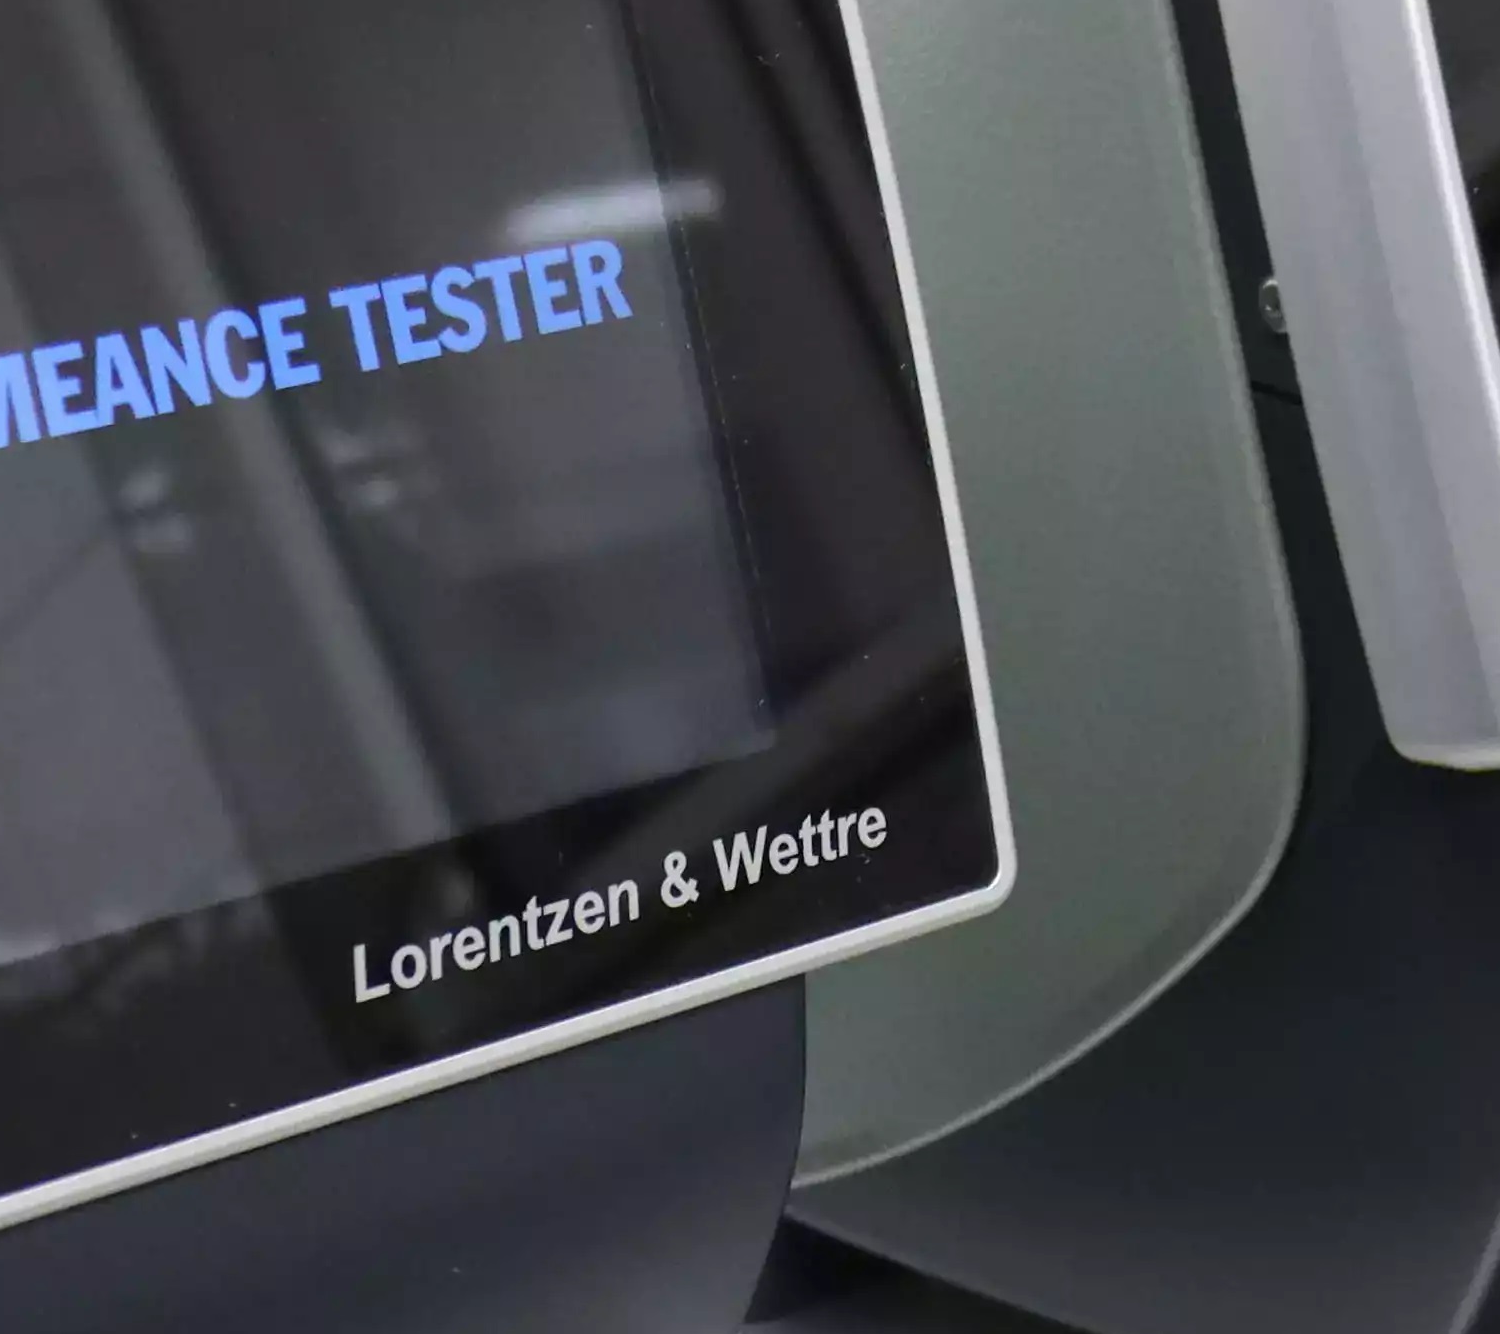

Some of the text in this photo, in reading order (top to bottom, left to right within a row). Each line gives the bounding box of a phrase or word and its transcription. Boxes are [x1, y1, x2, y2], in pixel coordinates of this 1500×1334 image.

[330, 239, 633, 374] TESTER
[352, 807, 888, 1003] Lorentzen & Wettre
